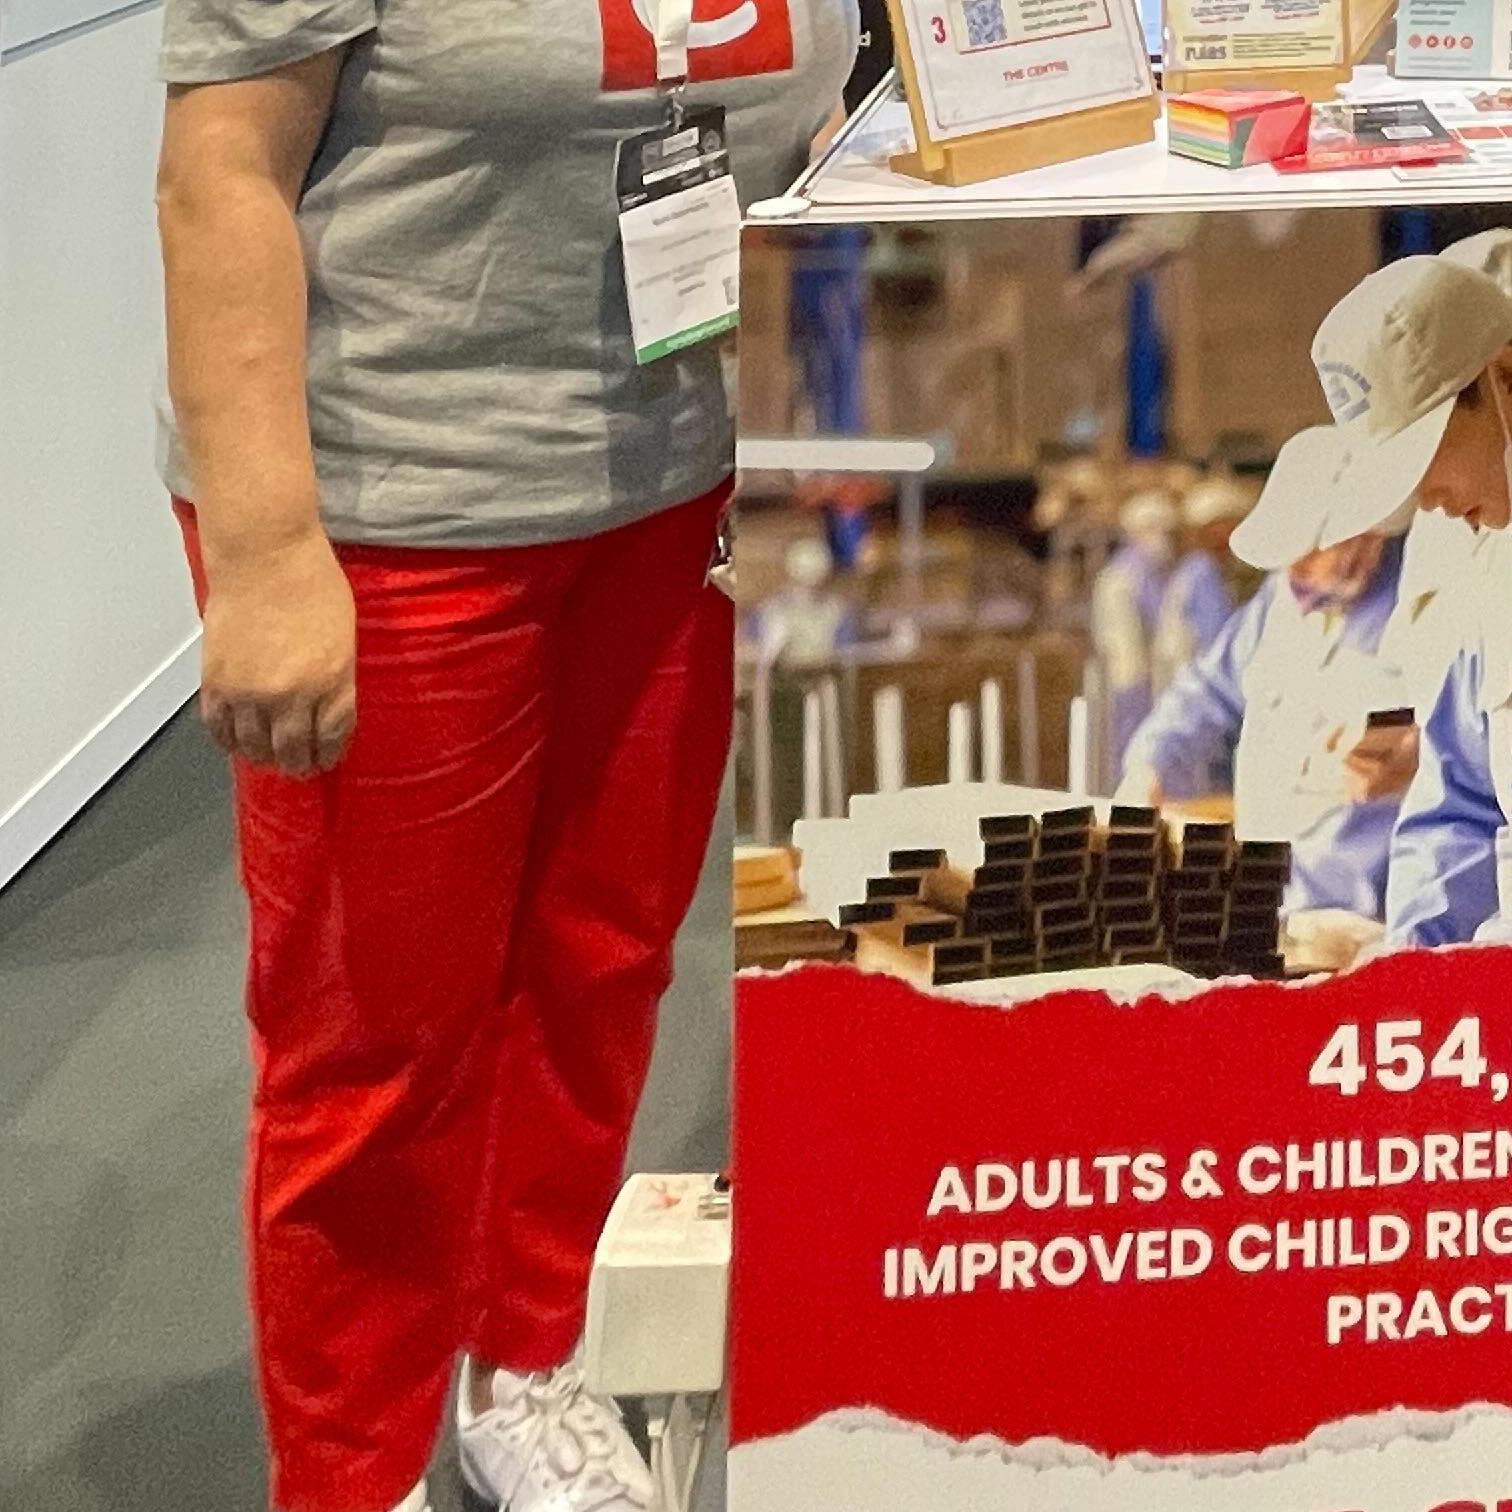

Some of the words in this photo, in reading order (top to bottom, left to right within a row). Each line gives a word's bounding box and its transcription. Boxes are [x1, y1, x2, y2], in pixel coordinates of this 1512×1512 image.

[931, 15, 947, 44] 3
[926, 1152, 1168, 1216] ADULTS
[1180, 1149, 1224, 1199] &
[883, 1228, 1213, 1298] IMPROVED
[1228, 1214, 1411, 1272] CHILD
